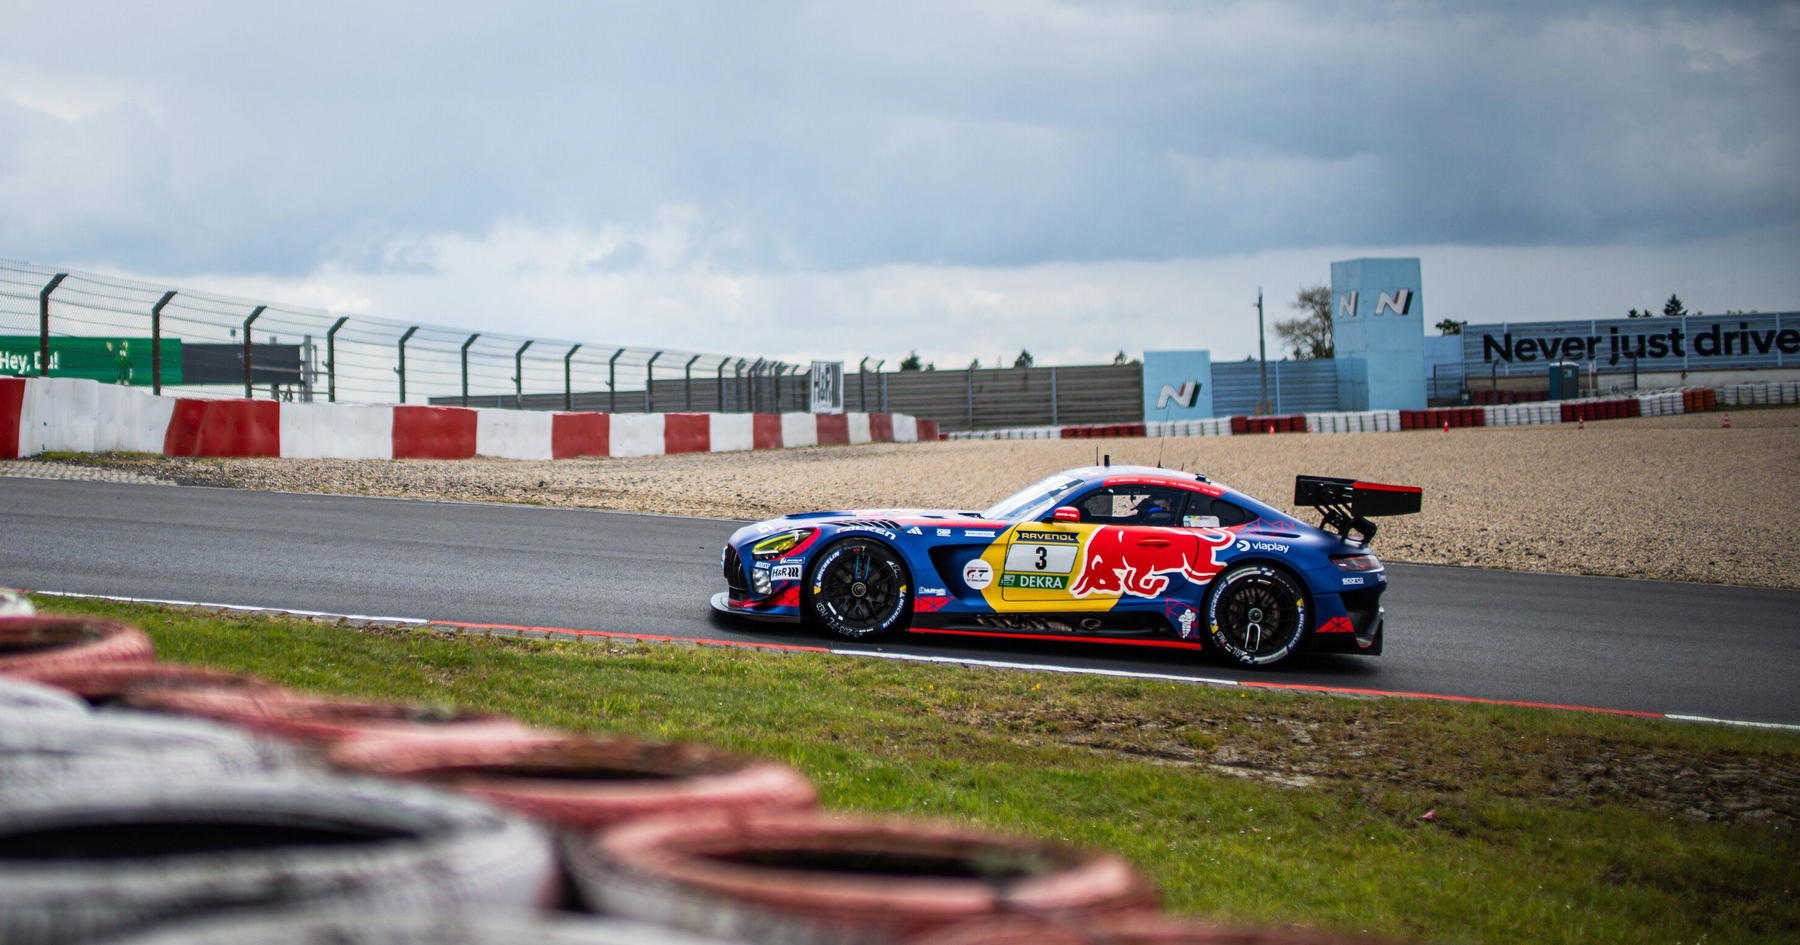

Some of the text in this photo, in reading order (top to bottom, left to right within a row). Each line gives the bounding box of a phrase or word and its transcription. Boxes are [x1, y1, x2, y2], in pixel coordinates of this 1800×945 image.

[1482, 321, 1800, 366] Never just drive
[0, 351, 31, 375] Hey,
[1021, 532, 1075, 541] RAVENOL
[1252, 541, 1290, 554] viaplay
[815, 550, 840, 584] MICHELIN
[1035, 546, 1047, 570] 3
[772, 567, 788, 577] H&R
[1020, 575, 1063, 589] DEKRA
[882, 598, 905, 629] MICHELIN
